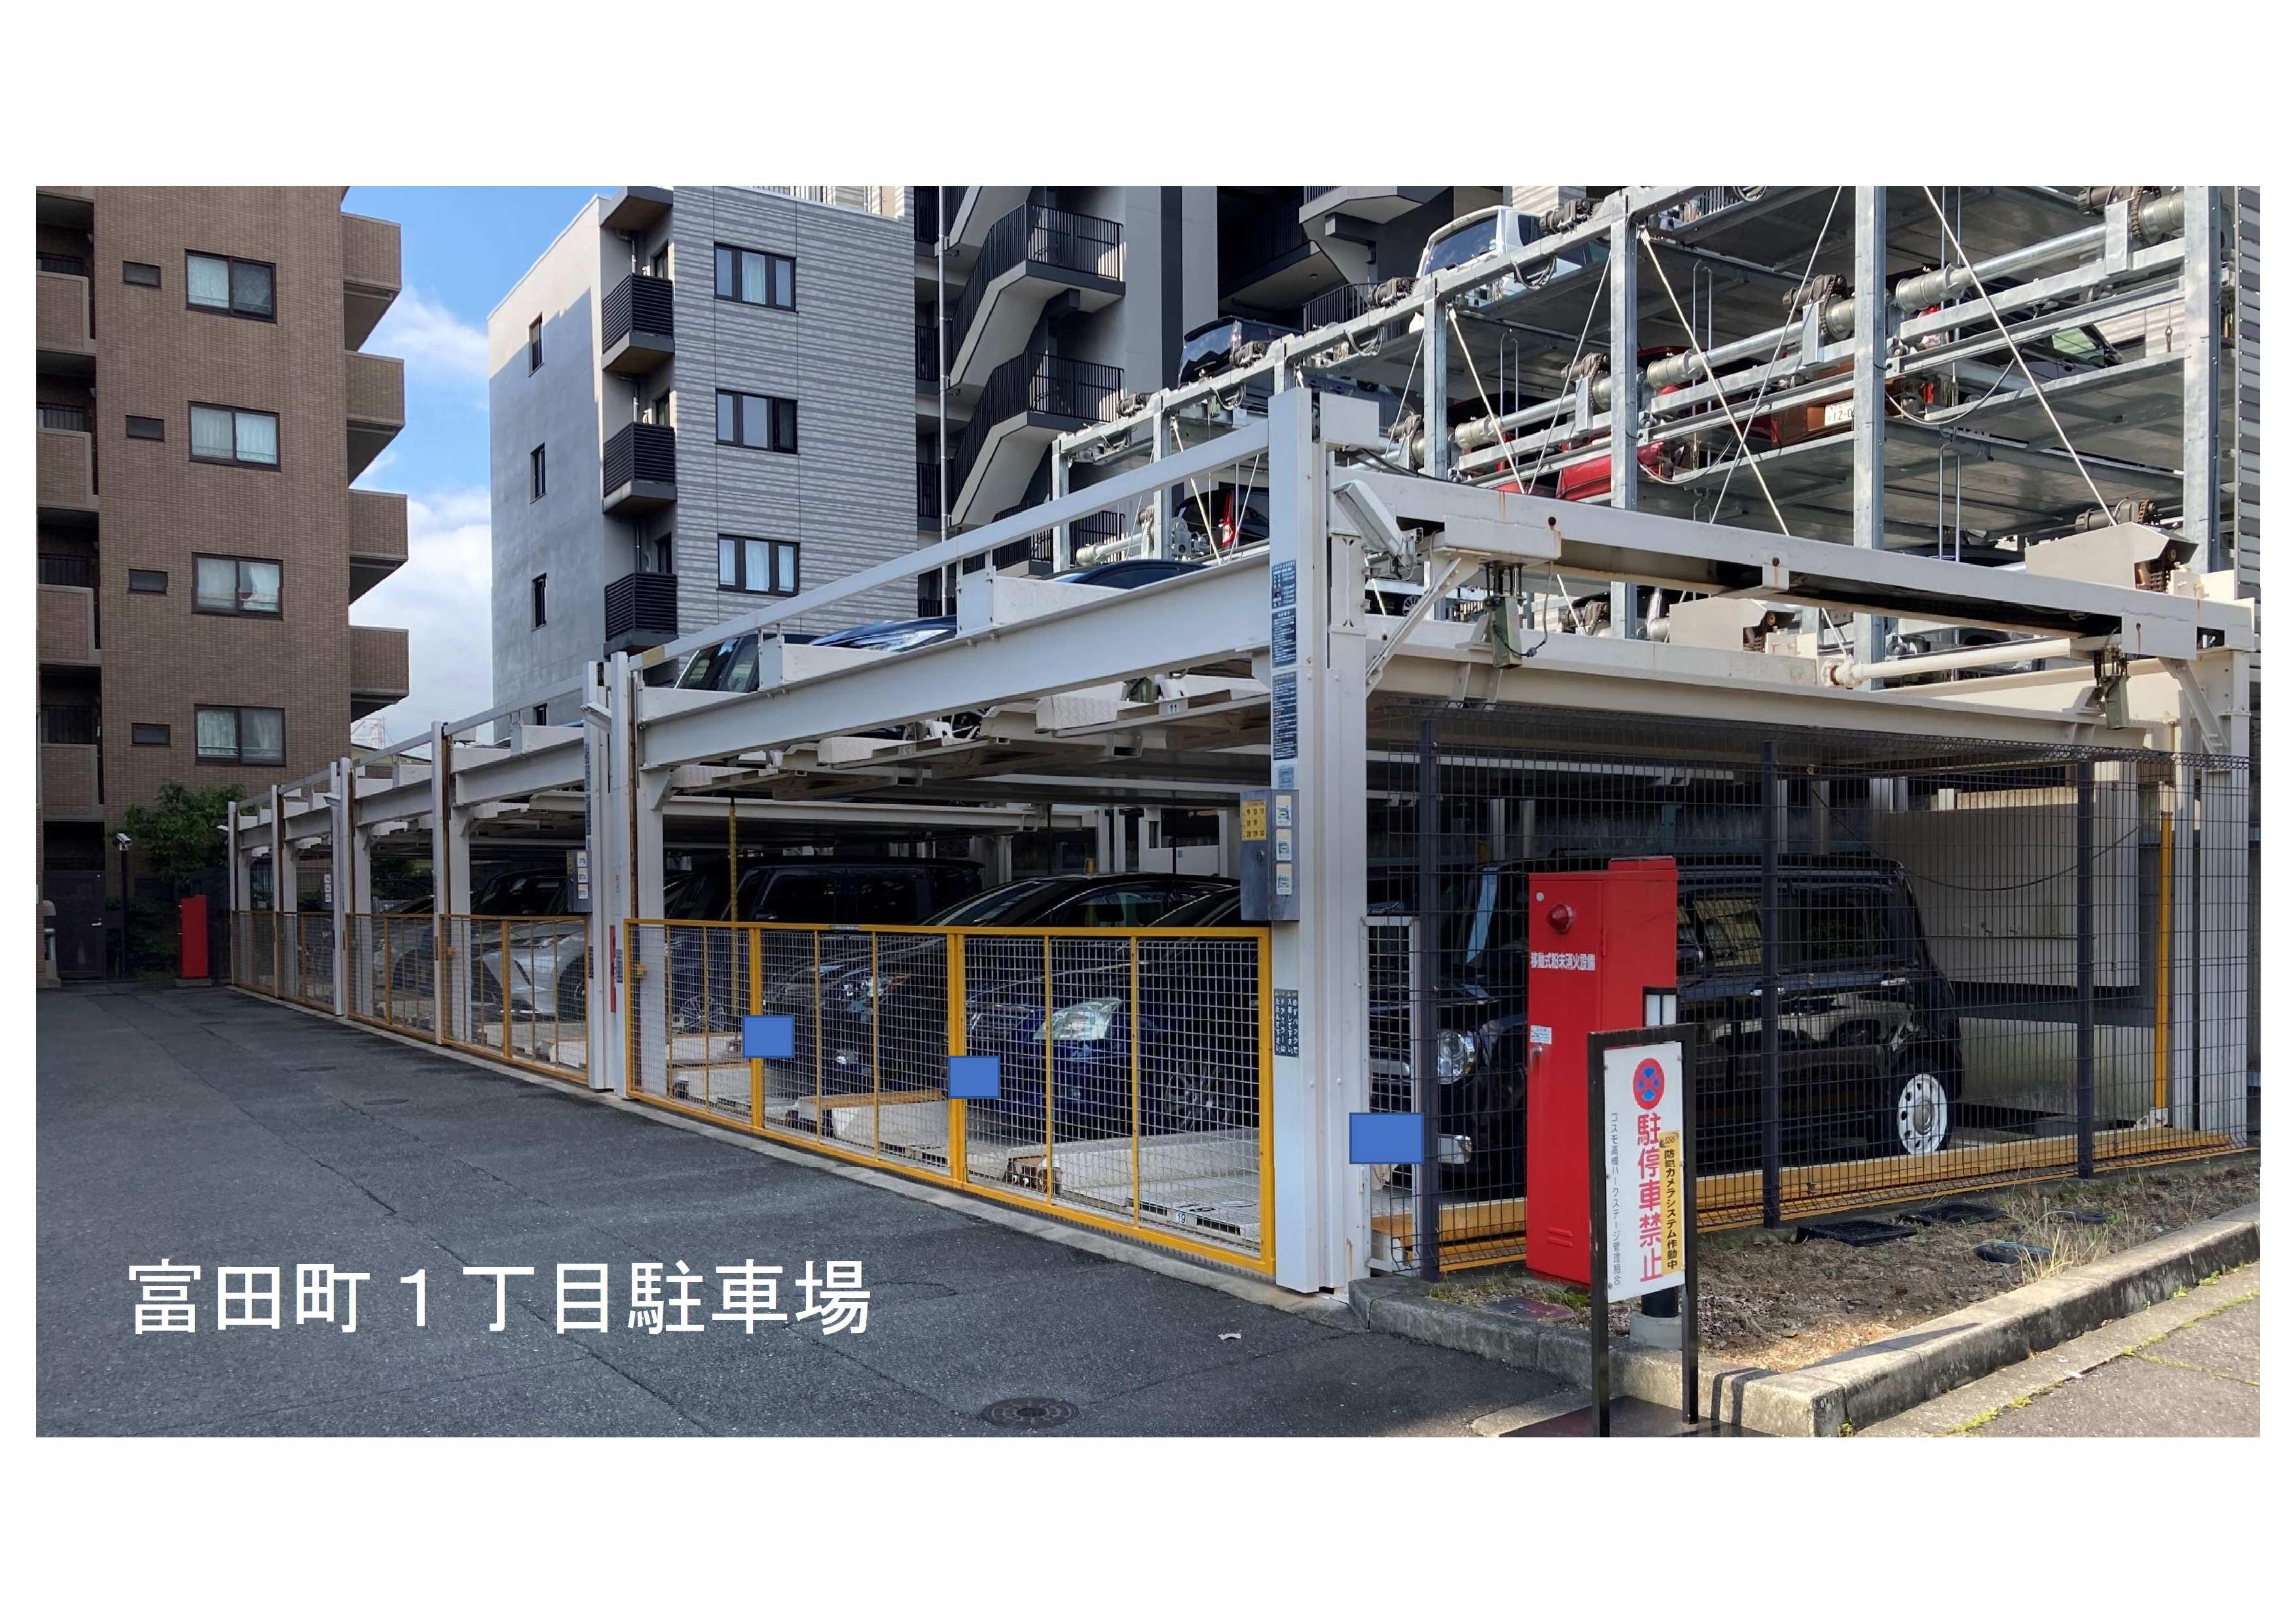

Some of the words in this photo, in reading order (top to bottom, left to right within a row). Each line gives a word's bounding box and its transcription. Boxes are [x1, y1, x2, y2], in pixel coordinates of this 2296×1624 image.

[1531, 951, 1595, 971] 移動式粉末消火設備
[1637, 1113, 1664, 1282] 駐停車禁止
[1664, 1149, 1677, 1269] 防犯カメラシステム作動中
